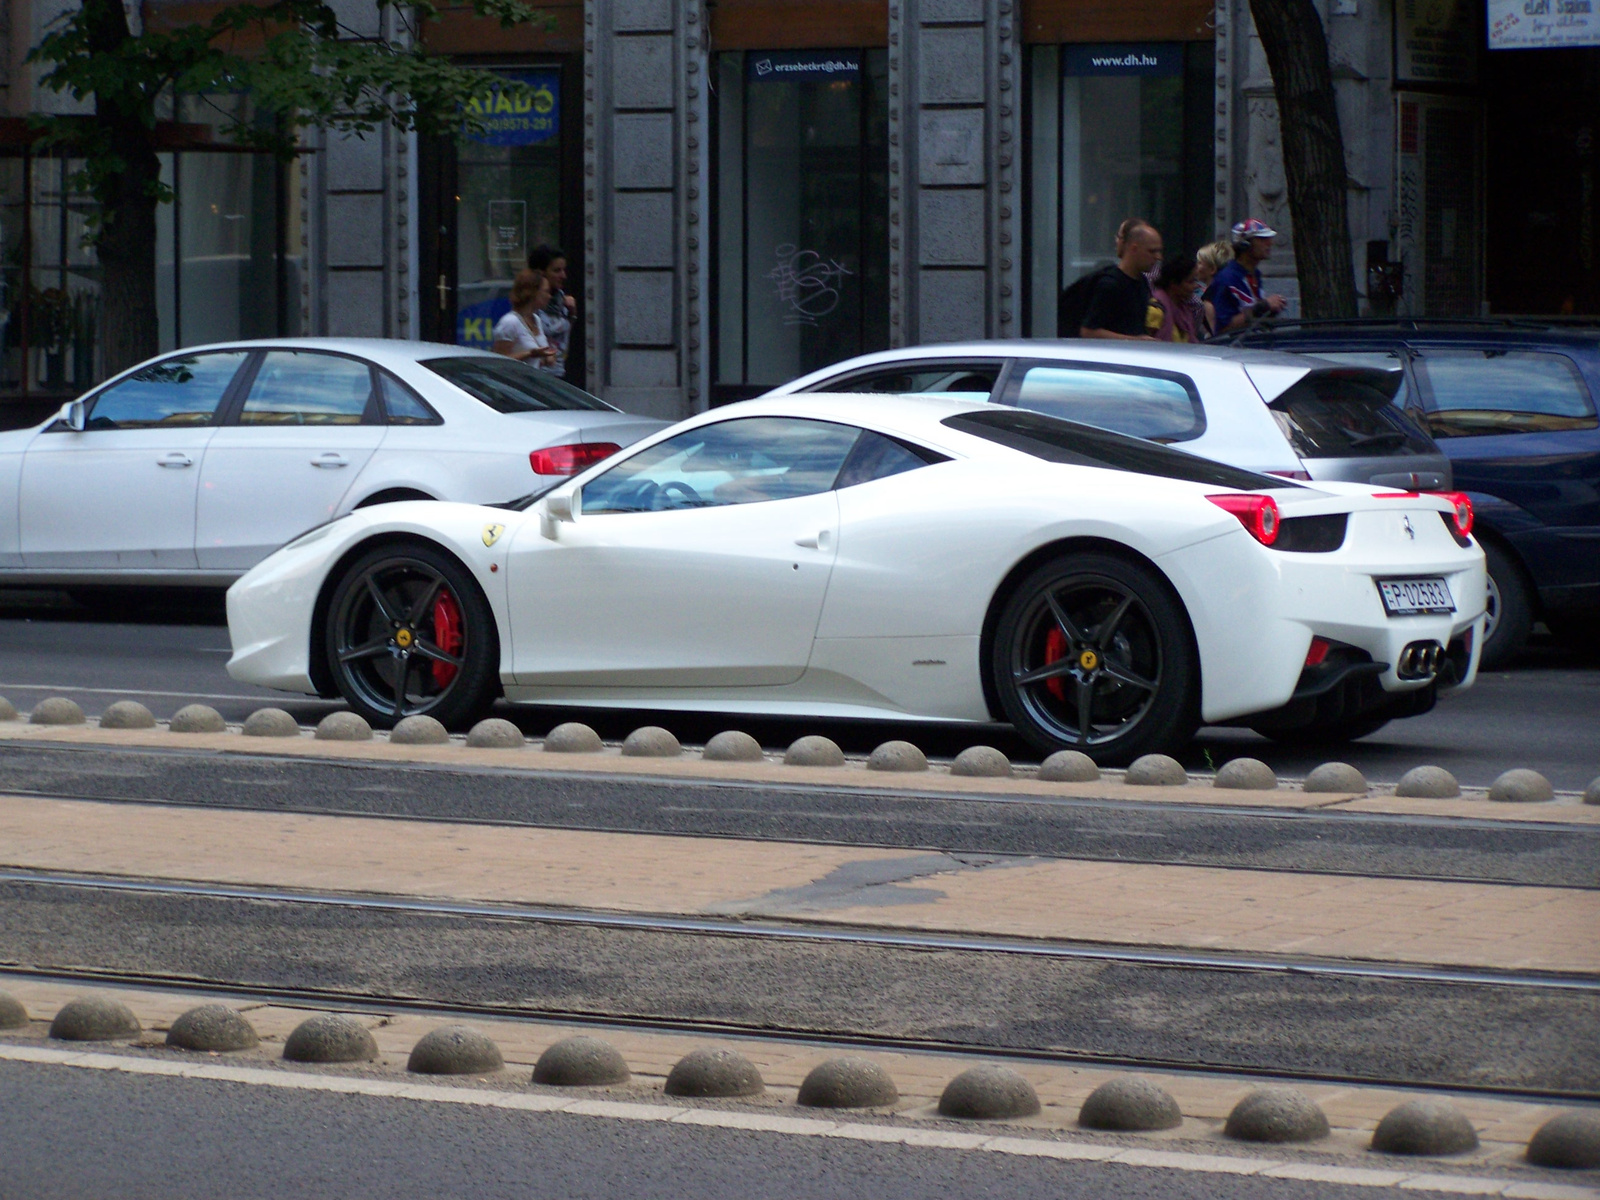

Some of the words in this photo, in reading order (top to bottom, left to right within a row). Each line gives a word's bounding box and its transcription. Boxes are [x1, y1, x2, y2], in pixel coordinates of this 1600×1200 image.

[1091, 54, 1157, 66] www.dh.hu
[464, 318, 492, 341] KI
[1391, 583, 1445, 606] P-02583
